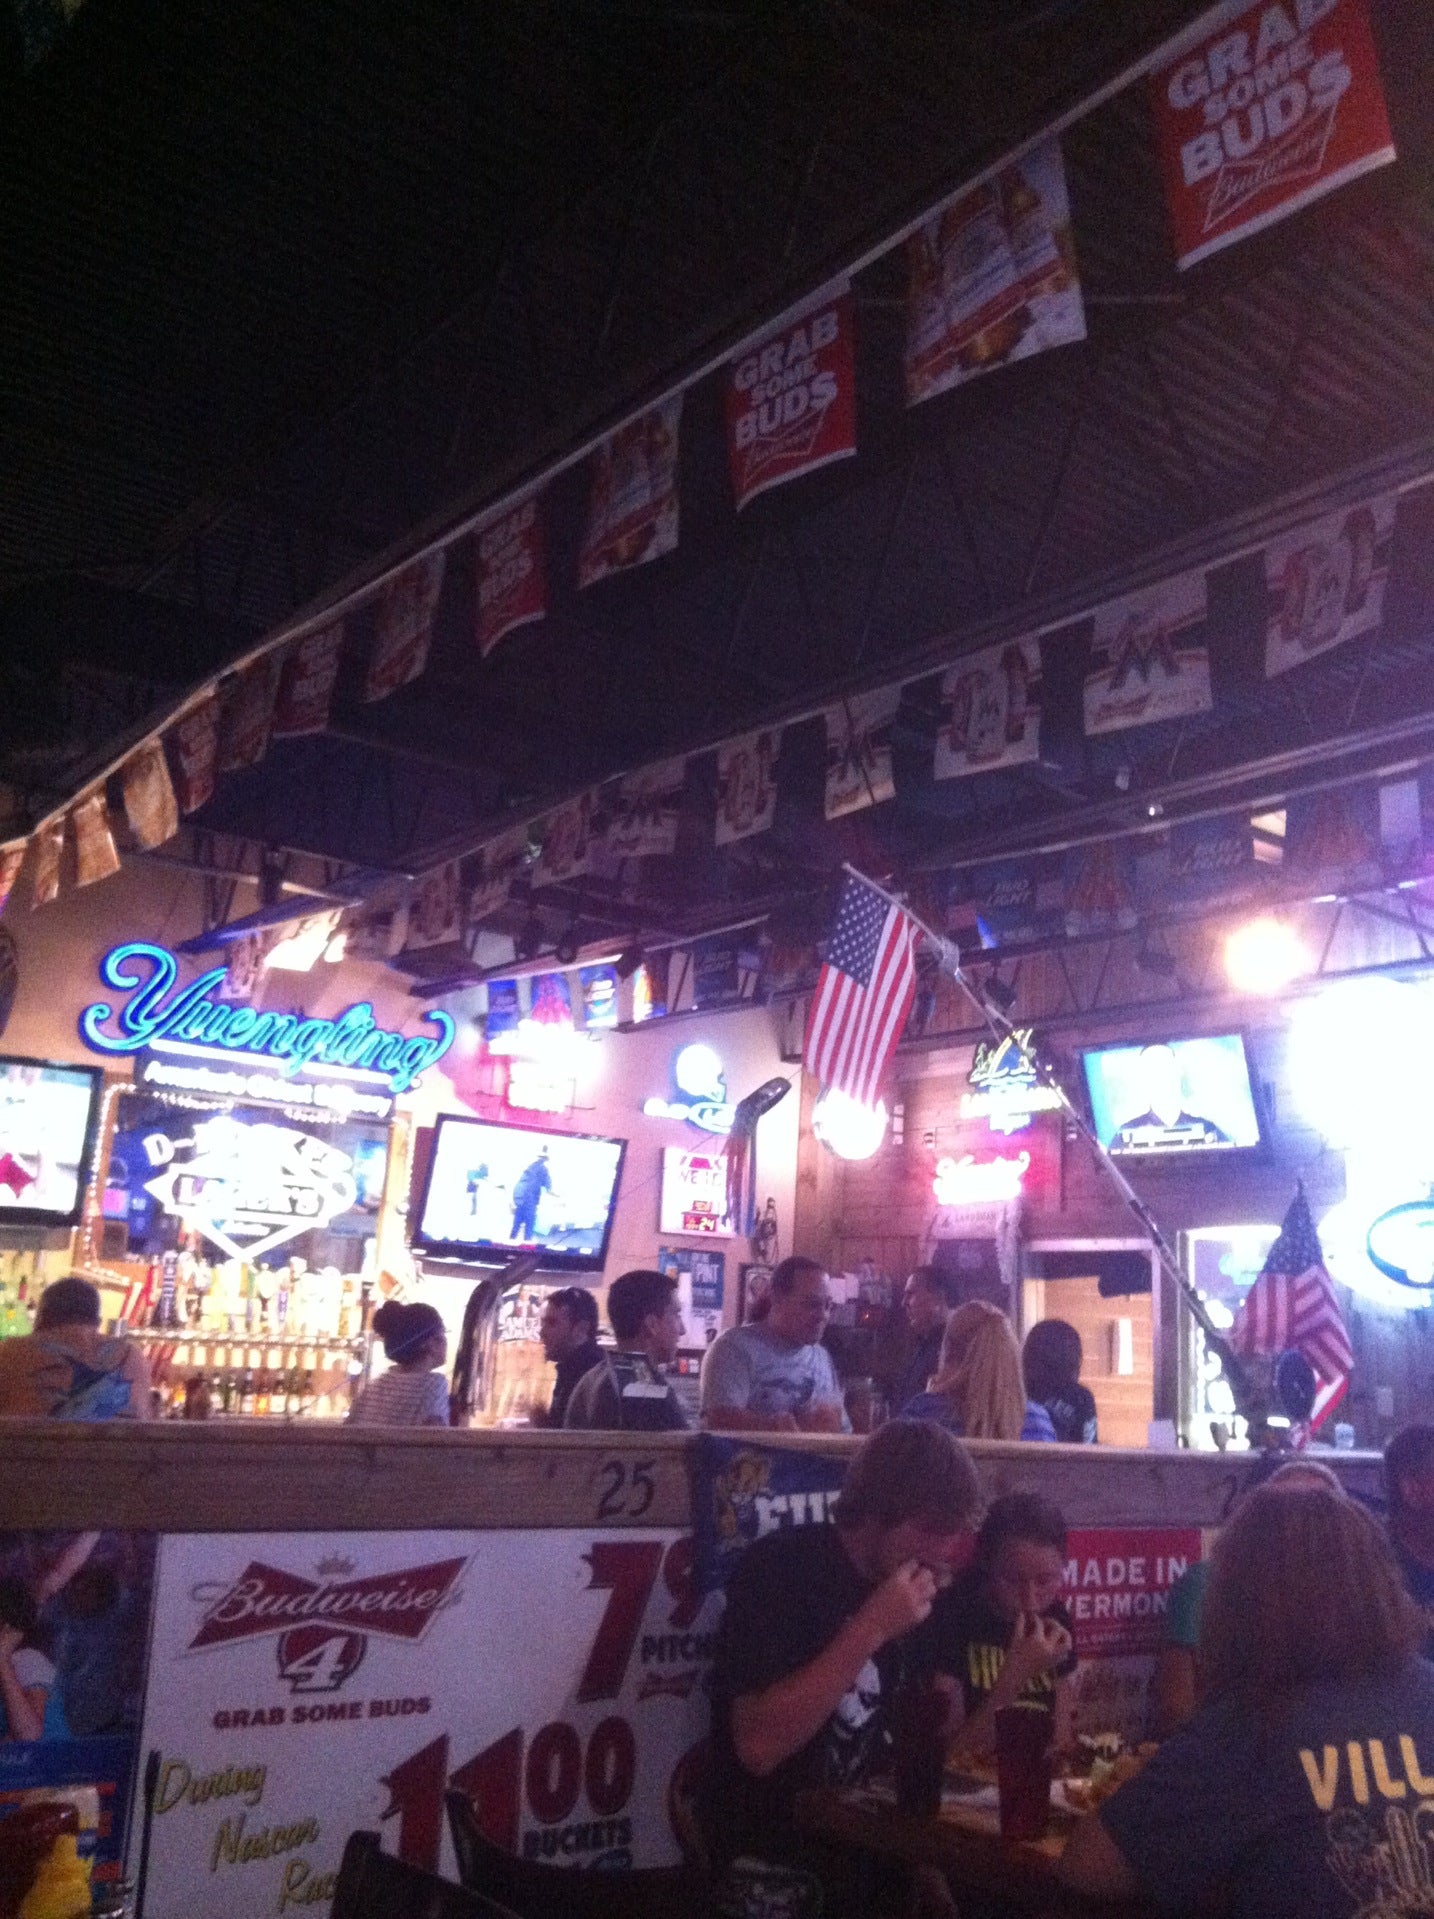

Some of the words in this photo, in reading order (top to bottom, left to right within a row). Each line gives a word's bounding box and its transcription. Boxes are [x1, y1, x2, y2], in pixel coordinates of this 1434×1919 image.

[1180, 49, 1353, 187] BUDS
[734, 311, 840, 392] GRAB
[734, 370, 839, 451] BUDS
[79, 941, 456, 1093] Yuengling
[598, 1459, 656, 1519] 25
[191, 1578, 465, 1623] Budweiser
[1062, 1557, 1147, 1588] MADE
[278, 1635, 352, 1693] 4
[212, 1707, 286, 1730] GRAB
[292, 1702, 363, 1725] SOME
[368, 1696, 432, 1719] BUDS
[153, 1759, 267, 1815] During
[523, 1816, 634, 1859] BUCKETS
